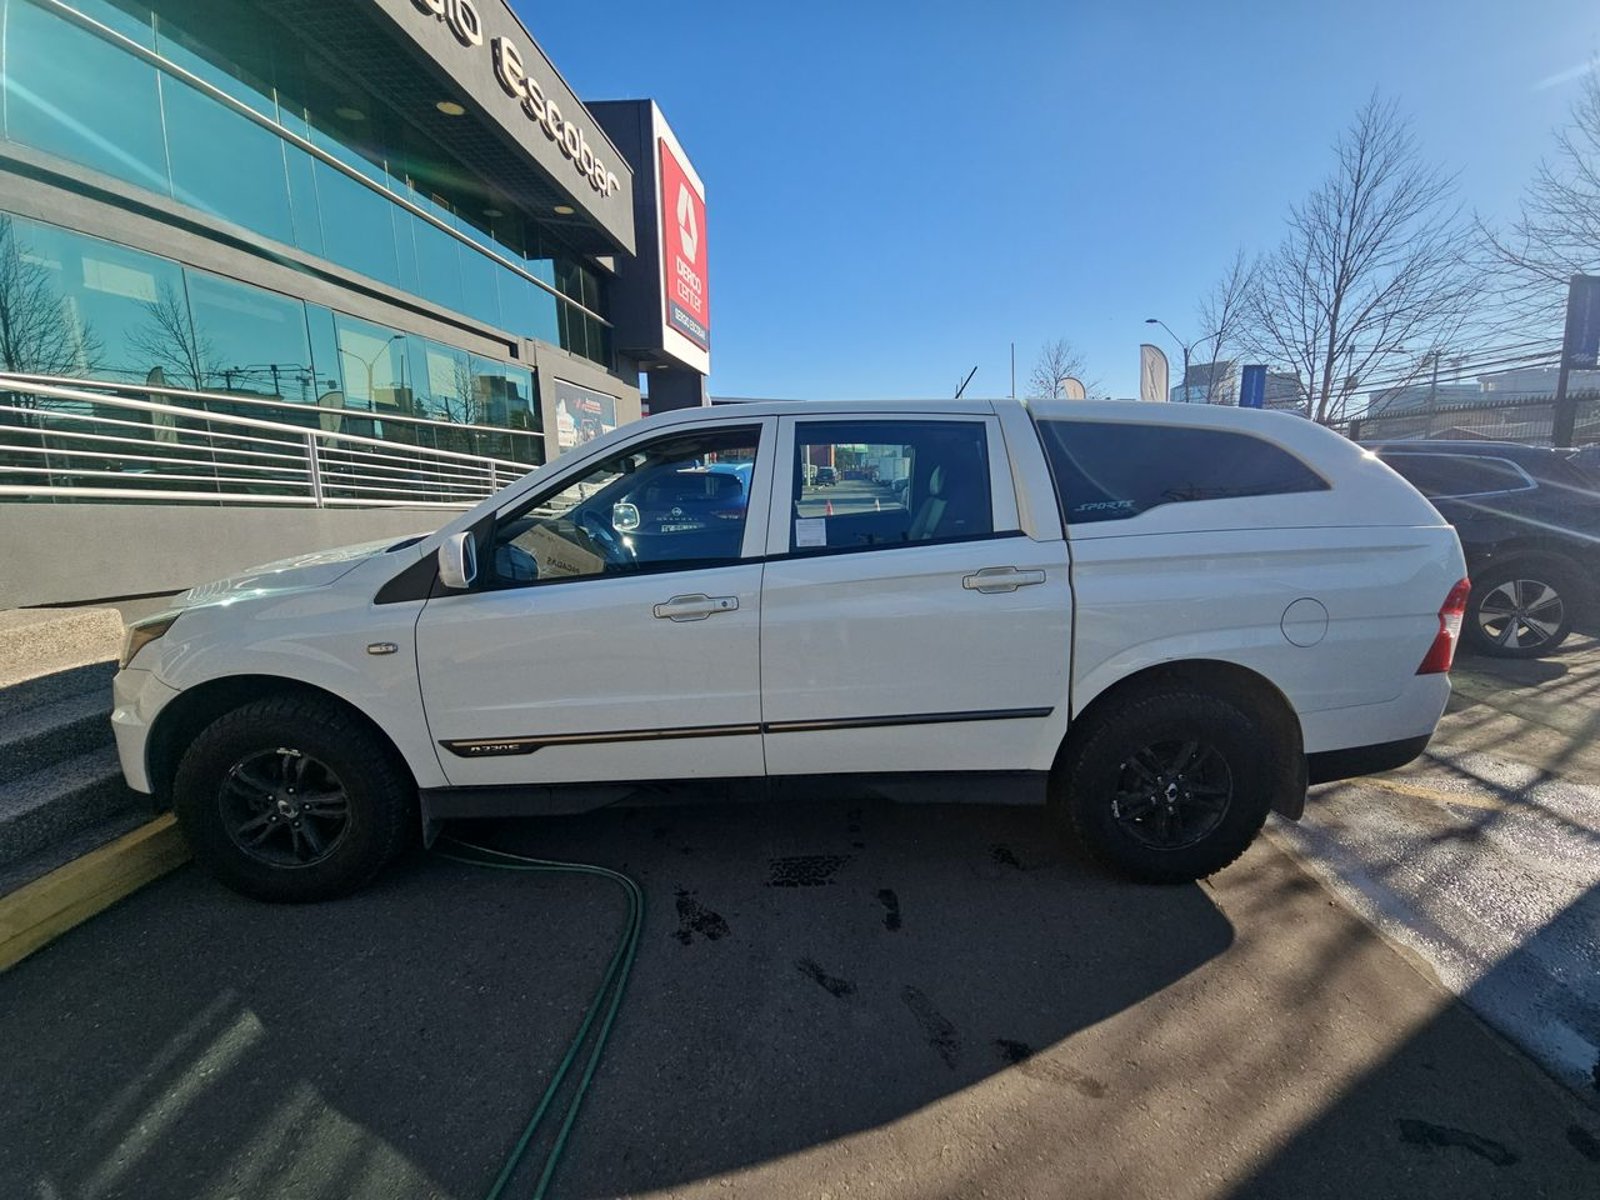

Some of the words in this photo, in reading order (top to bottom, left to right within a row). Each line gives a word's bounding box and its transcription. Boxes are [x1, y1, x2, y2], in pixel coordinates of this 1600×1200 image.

[493, 36, 620, 198] Escobar
[676, 255, 702, 295] DERCO
[677, 279, 702, 314] CENTER
